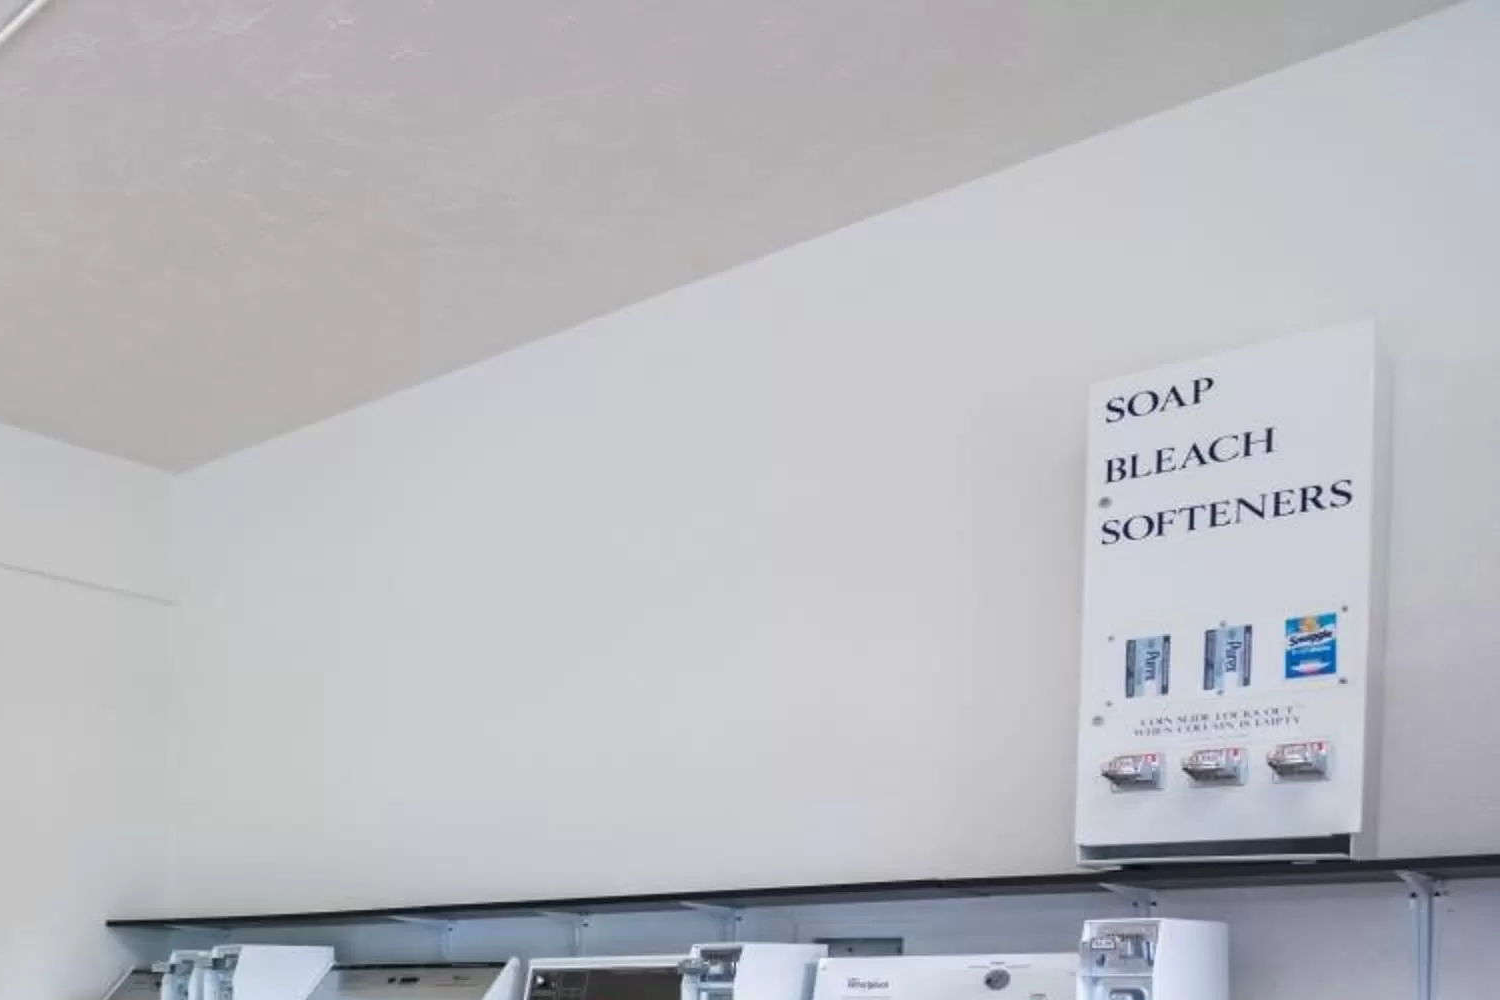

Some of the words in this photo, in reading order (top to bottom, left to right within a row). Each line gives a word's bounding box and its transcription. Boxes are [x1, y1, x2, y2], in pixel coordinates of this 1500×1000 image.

[1105, 377, 1214, 424] SOAP
[1105, 427, 1276, 484] BLEACH
[1101, 479, 1353, 545] SOFTENERS
